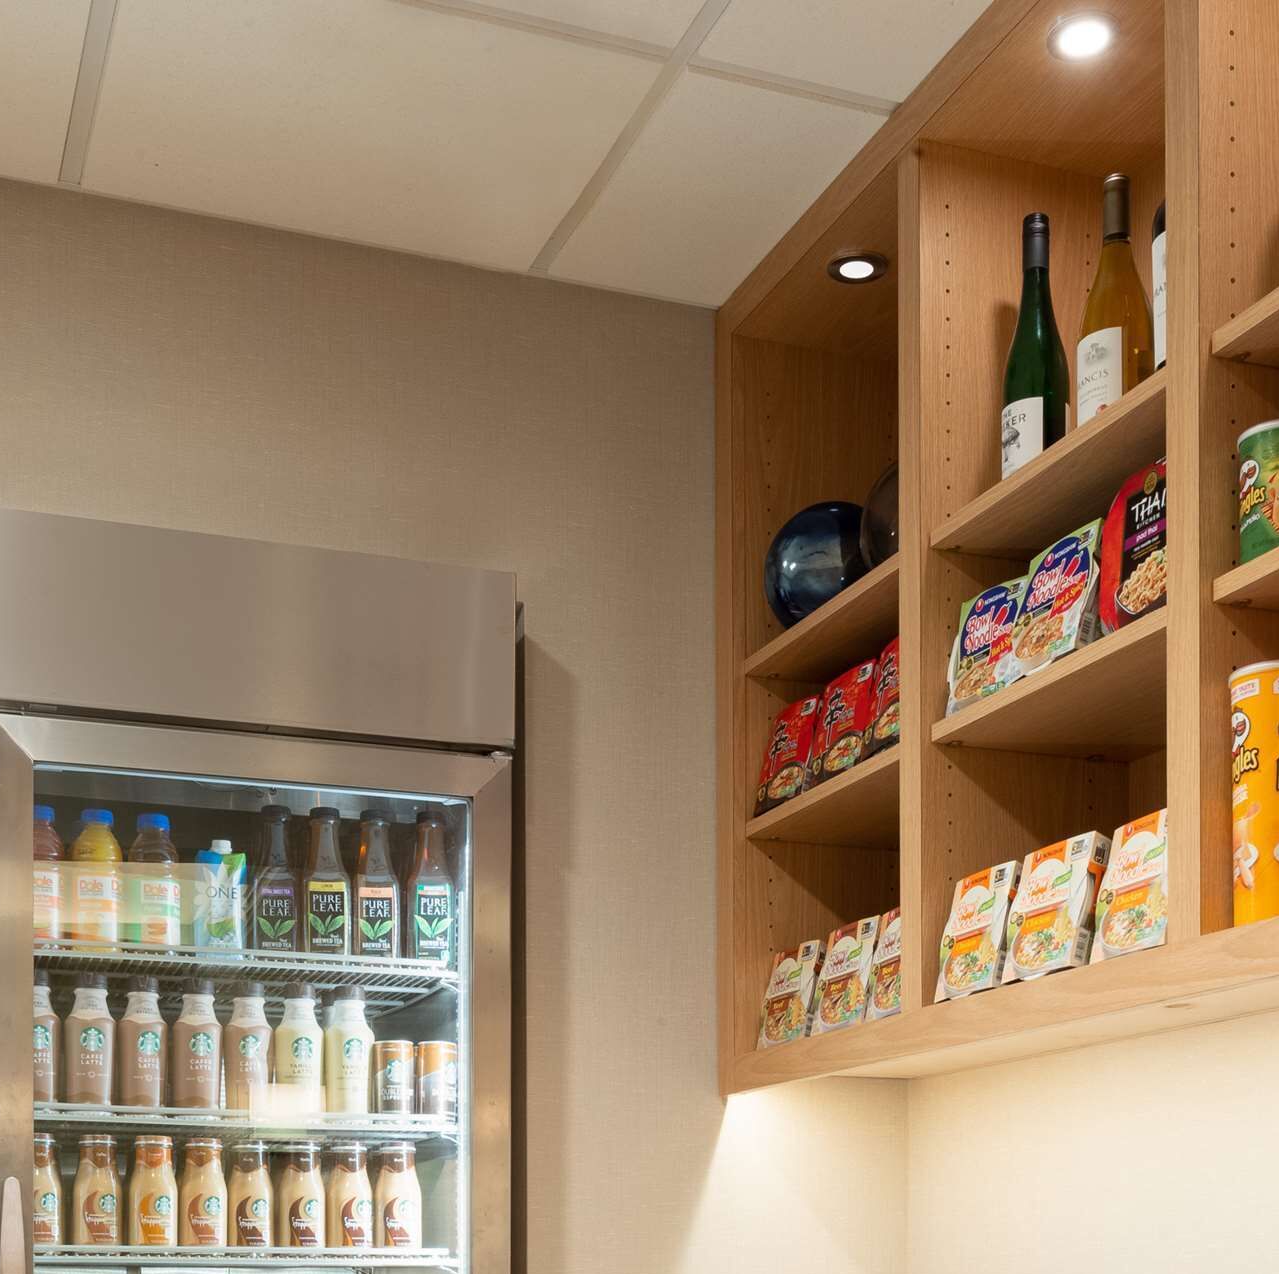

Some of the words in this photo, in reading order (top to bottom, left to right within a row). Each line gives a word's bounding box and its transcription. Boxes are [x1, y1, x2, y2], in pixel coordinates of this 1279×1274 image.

[1032, 558, 1066, 589] Bowl
[1027, 580, 1066, 611] Noodle
[966, 606, 995, 632] Bowl
[964, 624, 999, 655] Noodle
[80, 879, 104, 892] Dole
[143, 883, 168, 897] Dole
[207, 886, 238, 900] ONE
[313, 893, 341, 904] PURE
[262, 899, 289, 909] PURE
[363, 900, 390, 910] PURE
[421, 896, 448, 907] PURE
